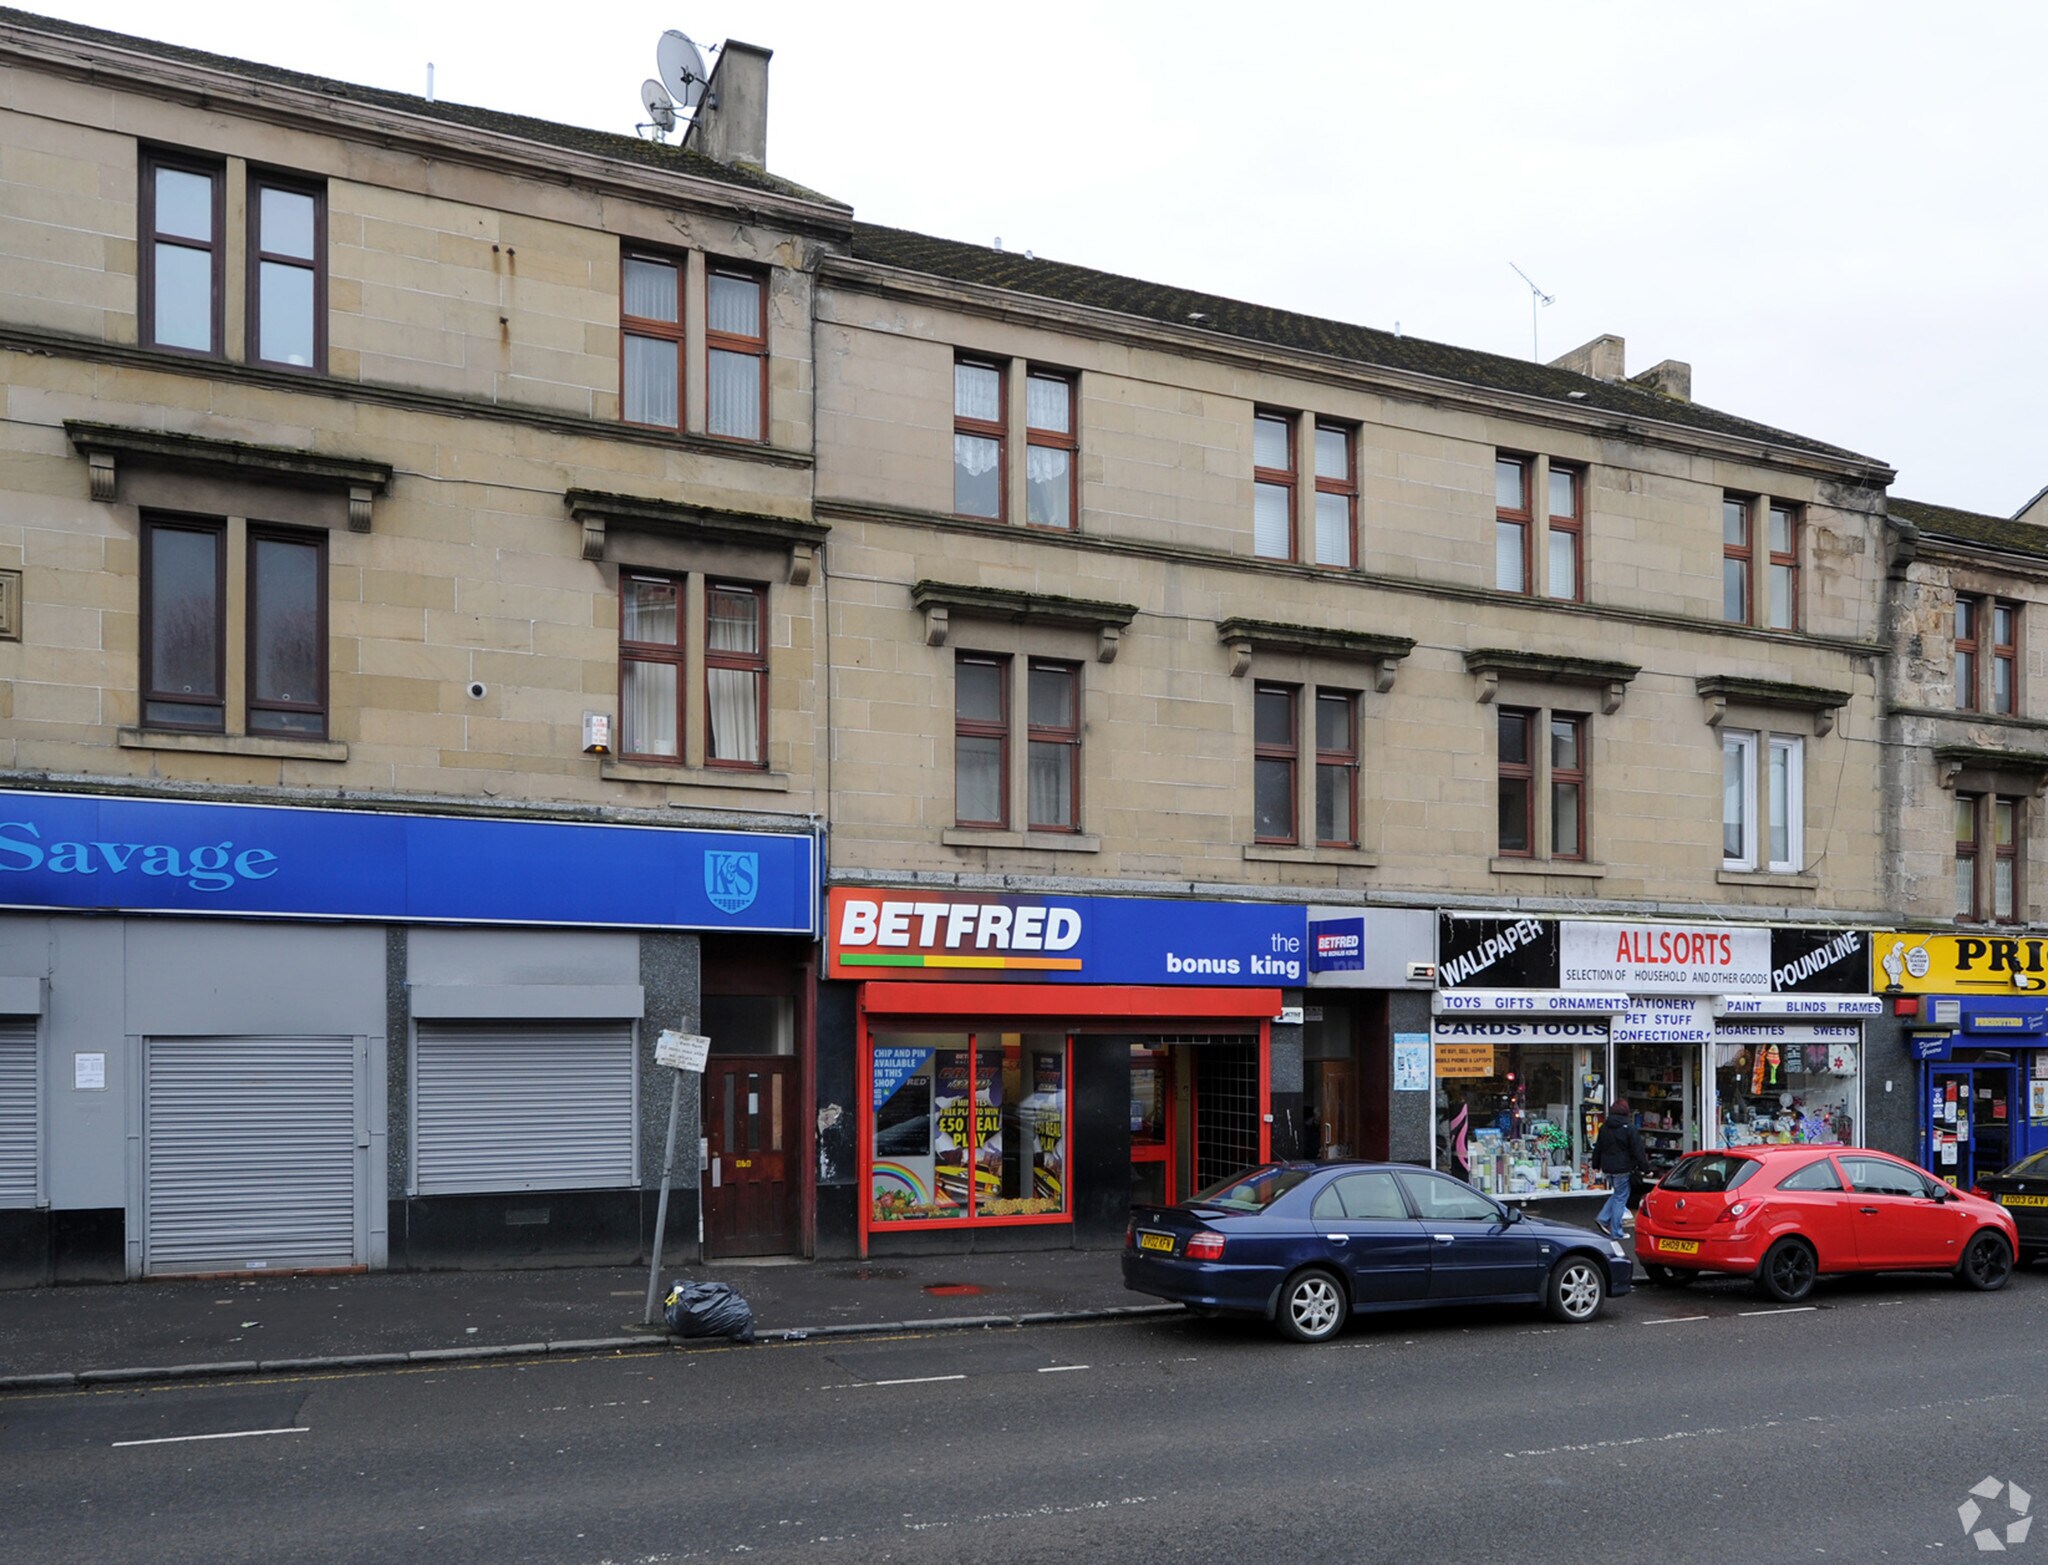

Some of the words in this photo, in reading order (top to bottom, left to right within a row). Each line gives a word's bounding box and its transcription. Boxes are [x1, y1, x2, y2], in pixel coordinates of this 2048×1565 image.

[0, 822, 279, 892] Savage
[839, 899, 1082, 951] BETFRED
[1271, 933, 1300, 953] the
[1318, 935, 1360, 949] BETFRED
[1616, 930, 1731, 966] ALLSORTS
[1440, 919, 1544, 987] WALLPAPER
[1955, 939, 2048, 972] PRI
[1166, 952, 1241, 975] bonus
[1251, 955, 1300, 980] king
[1772, 930, 1861, 991] POUNDLINE
[1566, 968, 1614, 981] SELECTION
[1615, 970, 1627, 981] OF
[1634, 970, 1687, 983] HOUSEHOLD
[1692, 972, 1711, 984] AND
[1712, 973, 1739, 984] OTHER
[1739, 973, 1769, 986] GOODS
[1445, 996, 1482, 1009] TOYS
[1495, 997, 1535, 1010] GIFTS
[1549, 997, 1629, 1010] ORNAMENTS
[1629, 997, 1697, 1011] TATIONERY
[1727, 1001, 1762, 1012] PAINT
[1786, 1001, 1827, 1013] BLINDS
[1838, 1002, 1882, 1014] FRAMES
[1624, 1013, 1647, 1025] PET
[1654, 1013, 1692, 1026] STUFF
[1715, 1024, 1785, 1036] CIGARETTES
[1813, 1025, 1856, 1037] SWEETS
[874, 1049, 893, 1058] CHIP
[894, 1049, 911, 1058] AND
[912, 1049, 926, 1058] PIN
[874, 1059, 916, 1069] AVAILABLE
[874, 1069, 883, 1078] IN
[884, 1069, 903, 1078] THIS
[874, 1079, 896, 1088] SHOP
[939, 1118, 965, 1132] £50
[966, 1117, 1001, 1131] EAL
[1680, 1241, 1694, 1251] NZF
